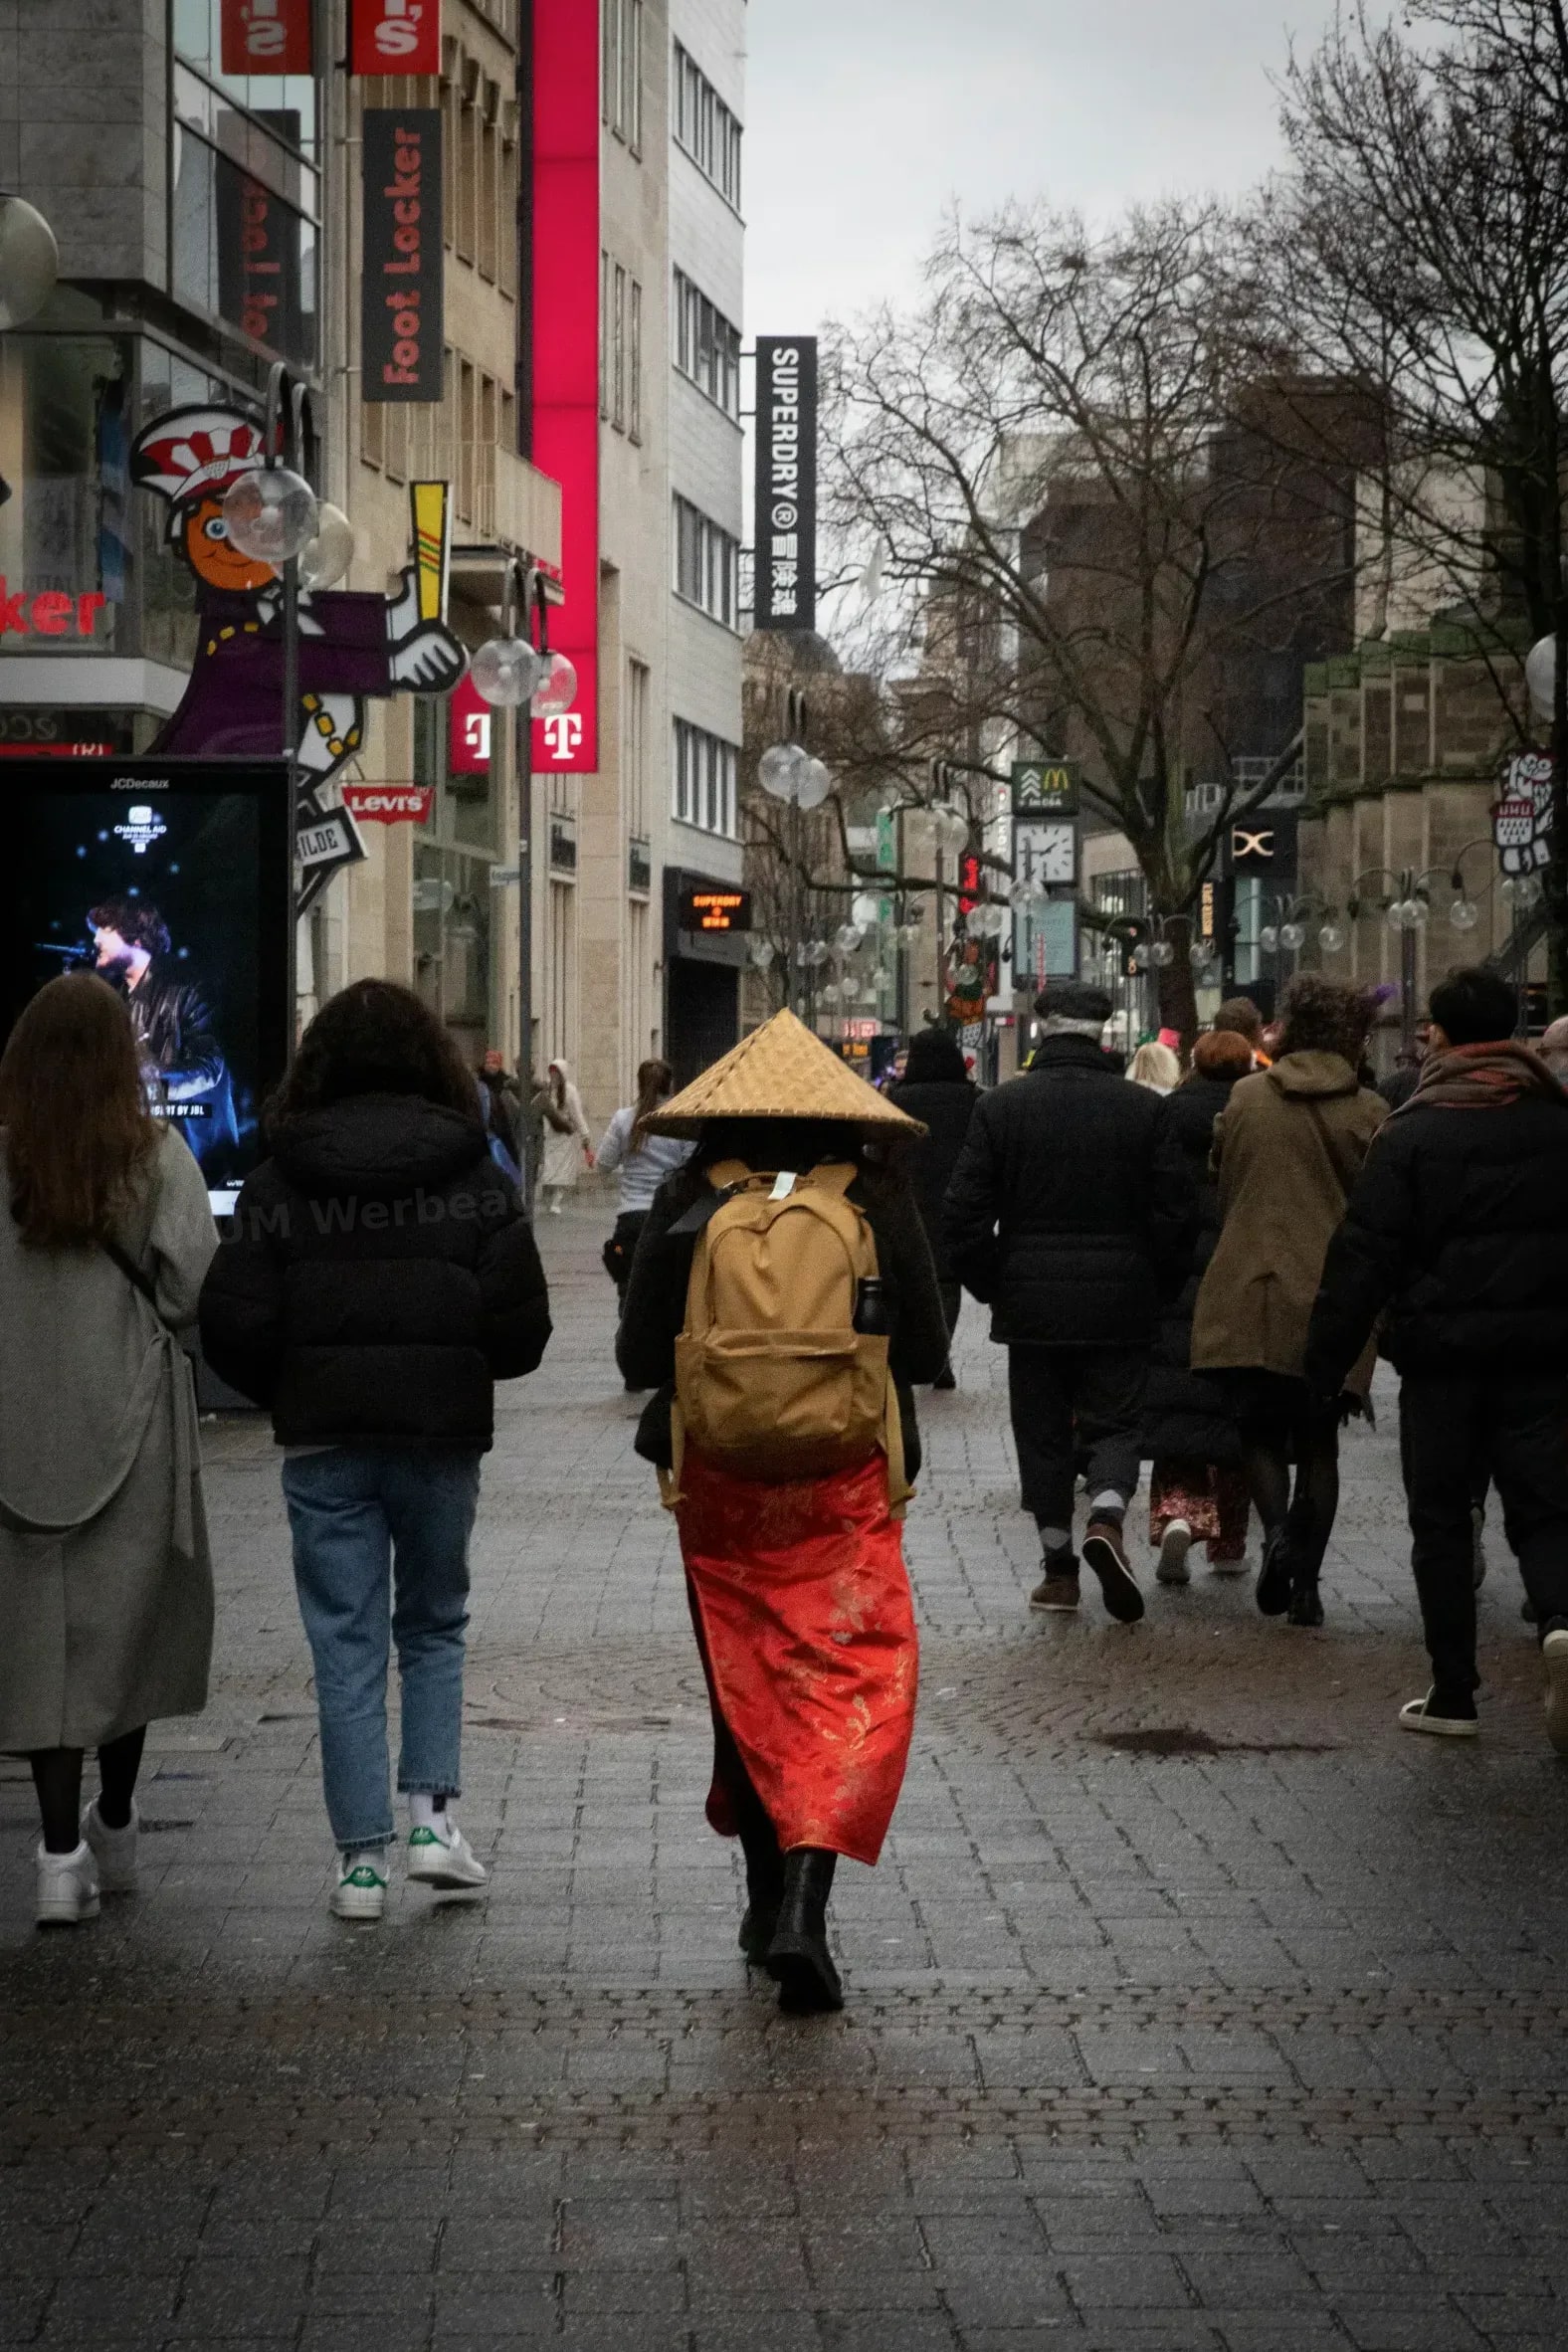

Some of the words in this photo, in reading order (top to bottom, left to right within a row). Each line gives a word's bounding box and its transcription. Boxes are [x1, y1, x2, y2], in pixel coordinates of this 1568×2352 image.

[383, 127, 421, 275] Locker
[383, 289, 421, 385] Foot
[771, 348, 799, 499] SUPERDRY
[109, 777, 170, 790] JCDecaux
